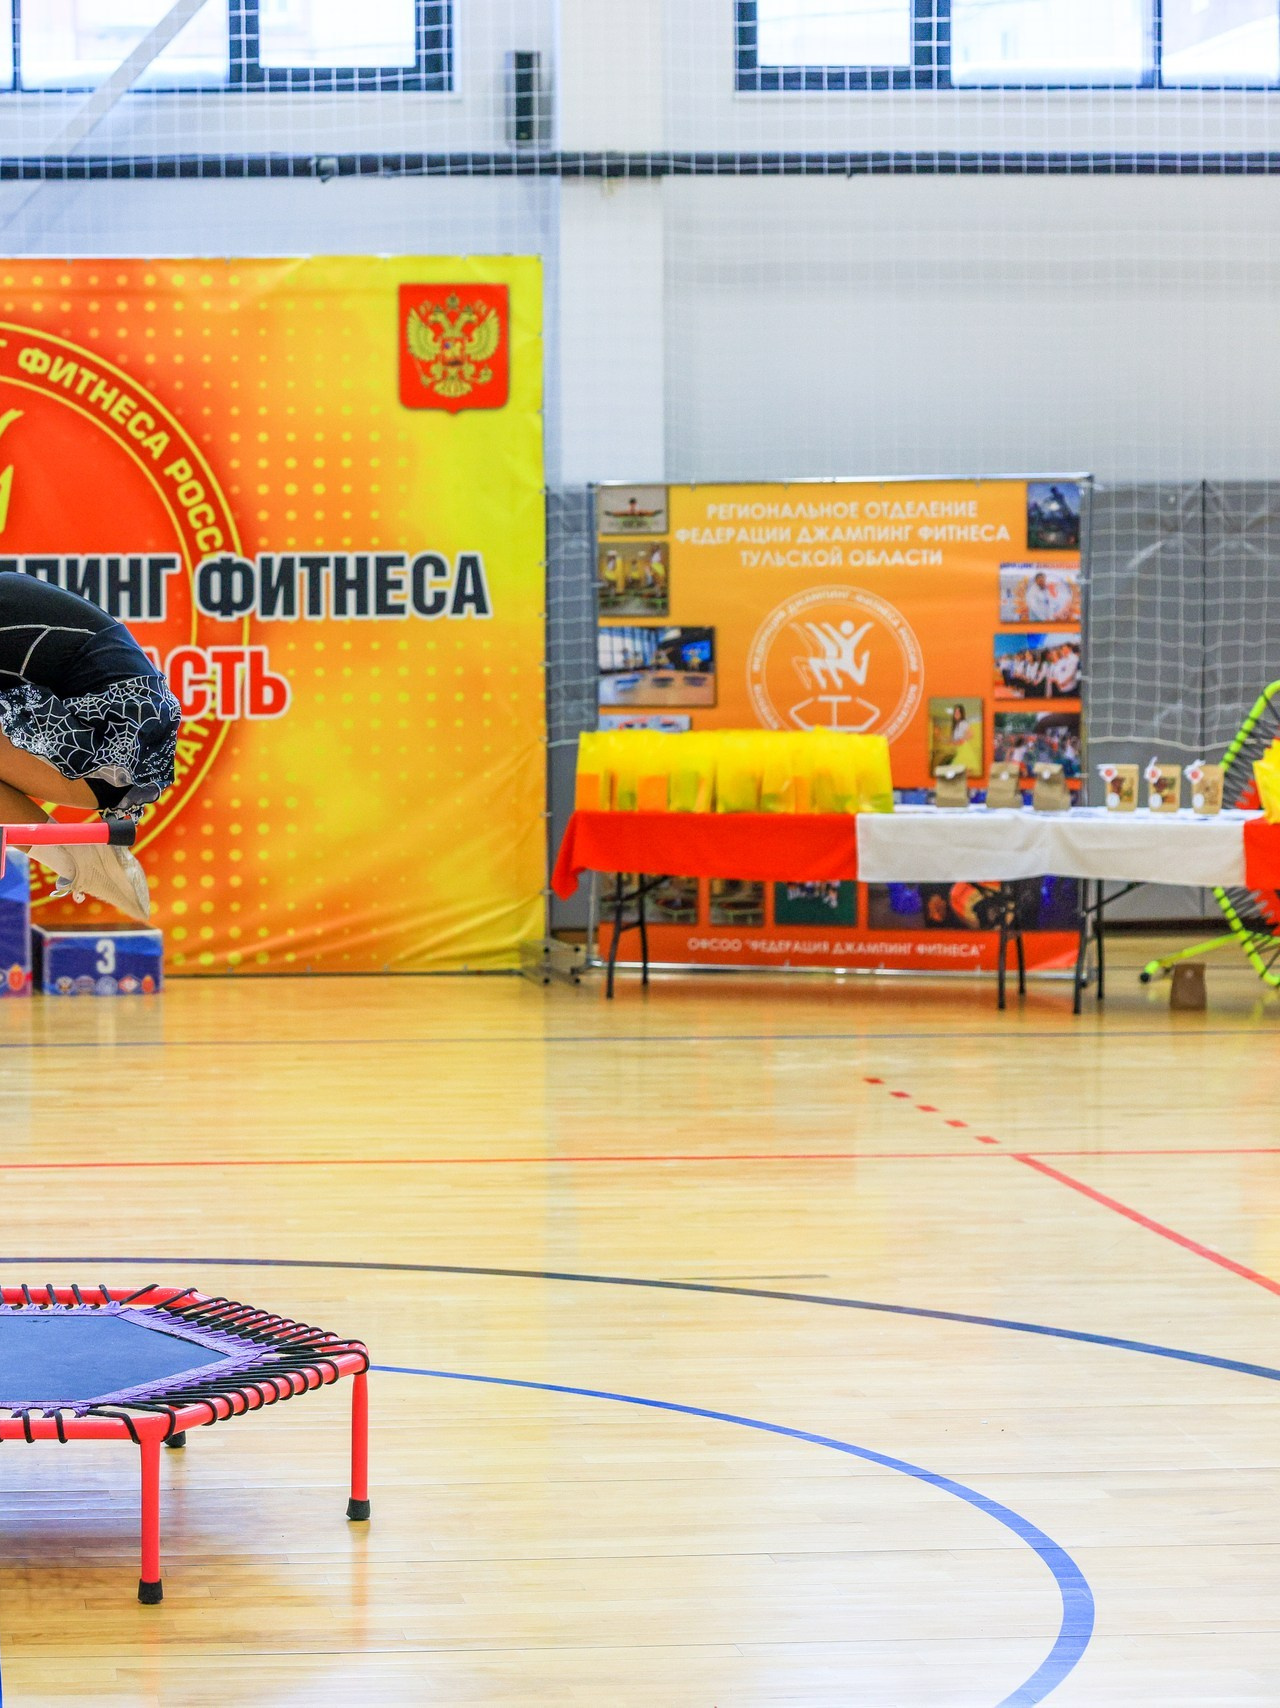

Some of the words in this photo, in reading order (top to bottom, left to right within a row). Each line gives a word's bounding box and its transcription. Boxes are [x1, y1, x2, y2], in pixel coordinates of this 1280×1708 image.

[17, 347, 171, 461] ФИТНЕСА
[163, 457, 224, 558] РОСС
[706, 501, 859, 521] РЕГИОНАЛЬНОЕ
[864, 500, 978, 519] ОТДЕЛЕНИЕ
[674, 525, 793, 546] ФЕДЕРАЦИИ
[796, 524, 914, 545] ДЖАМПИНГ
[917, 523, 1011, 543] ФИТНЕСА
[739, 546, 843, 568] ТУЛЬСКОЙ
[848, 547, 942, 568] ОБЛАСТИ
[196, 552, 489, 620] ФИТНЕСА
[96, 939, 116, 974] 3
[832, 940, 912, 956] ДЖАМПИНГ
